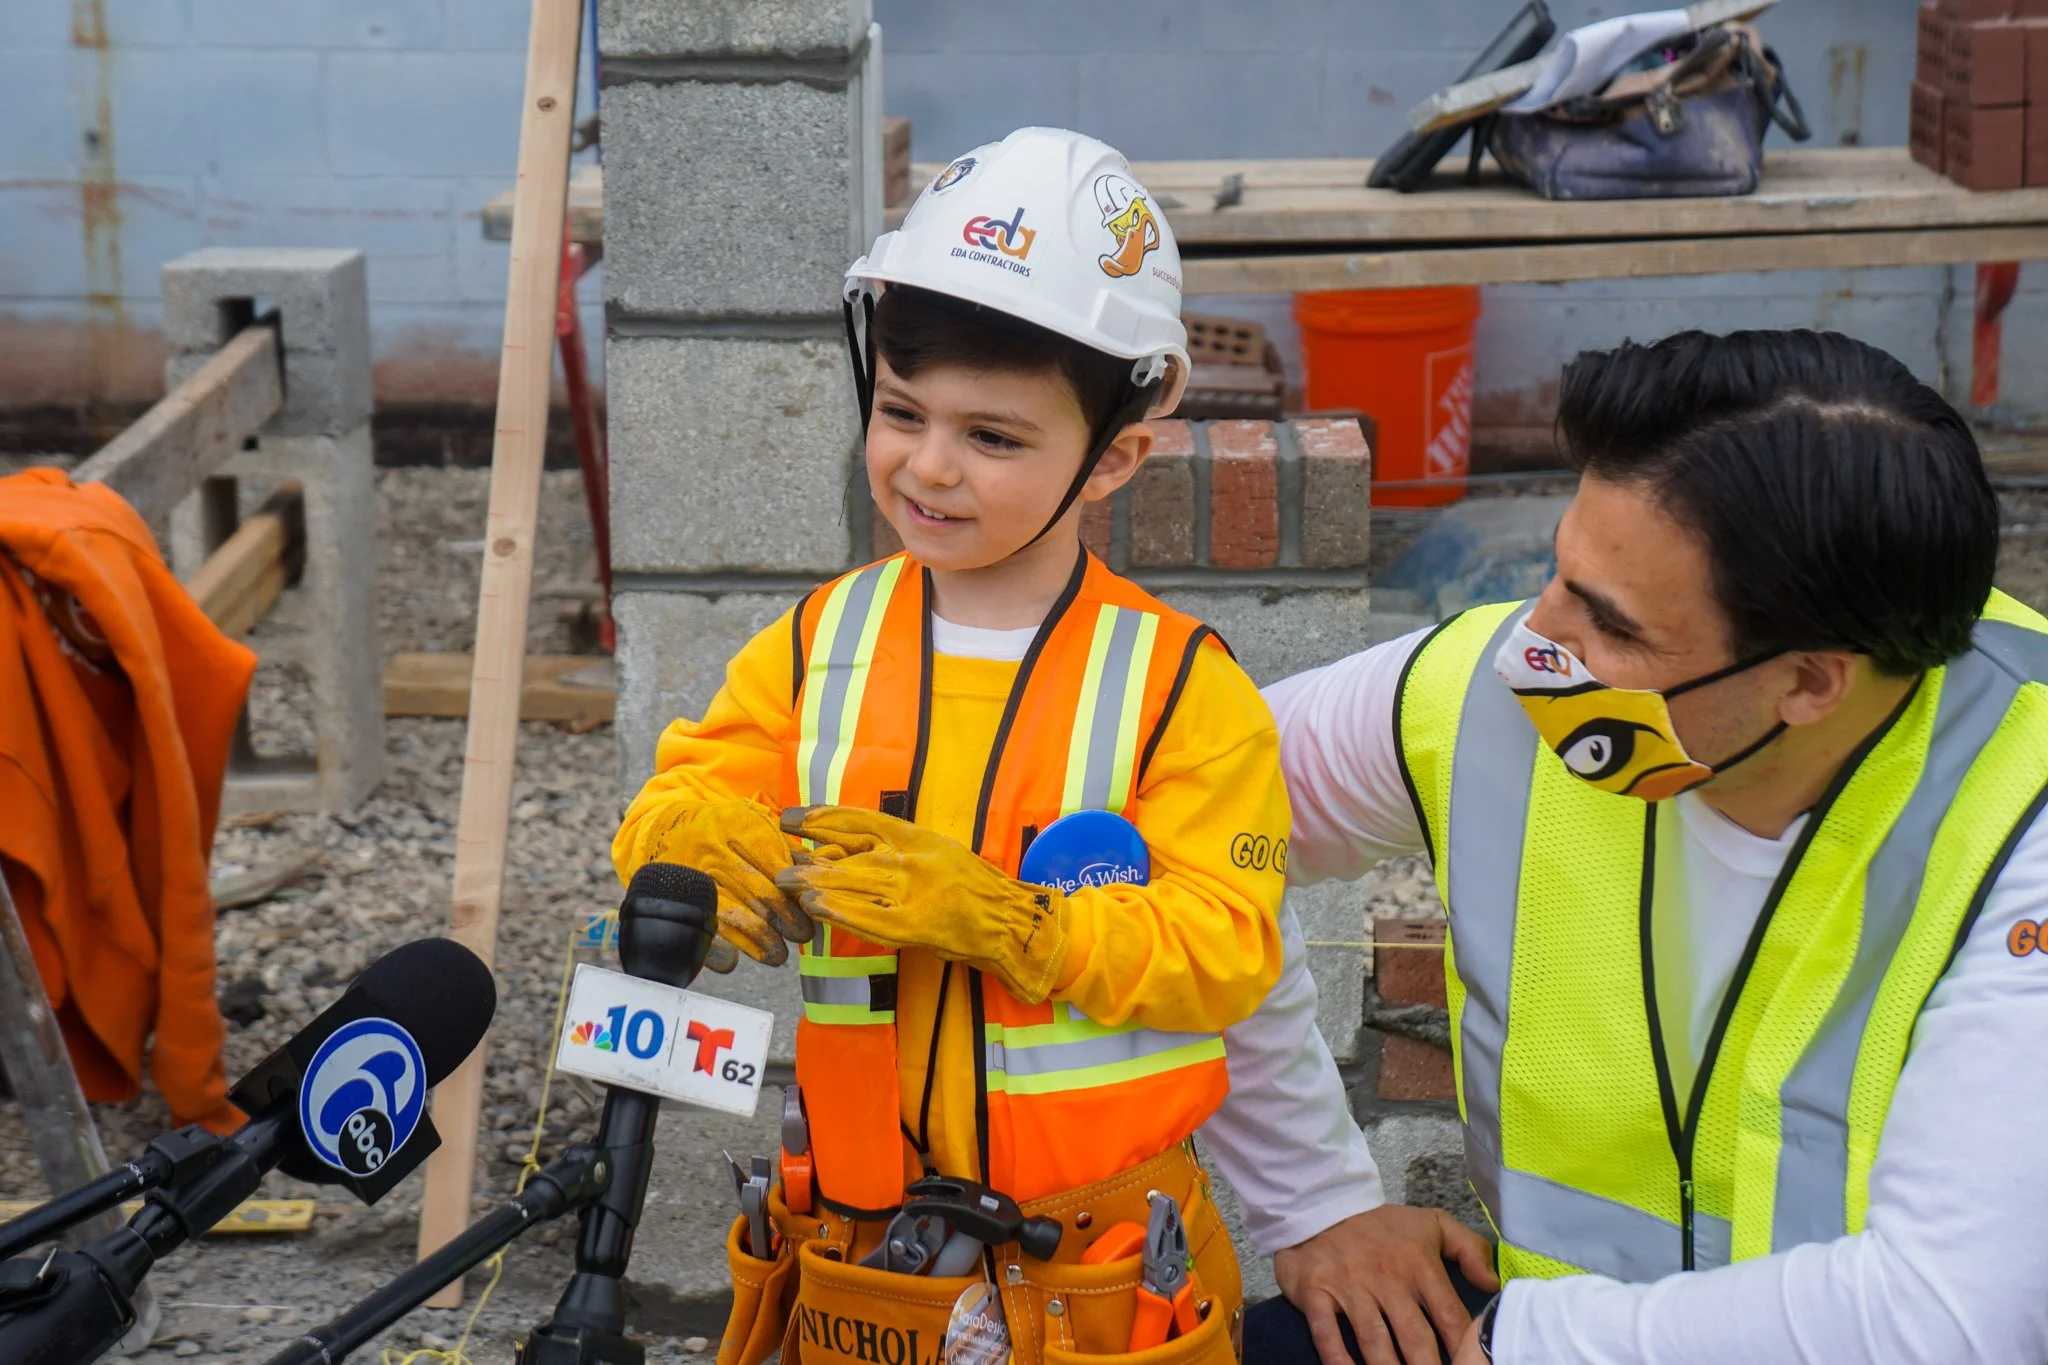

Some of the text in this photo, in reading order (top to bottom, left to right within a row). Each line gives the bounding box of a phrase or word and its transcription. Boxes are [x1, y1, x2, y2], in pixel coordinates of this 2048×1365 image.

[963, 207, 1036, 261] eda
[951, 247, 1031, 277] EDA CONTRACTORS
[1231, 832, 1270, 870] GO
[607, 1004, 665, 1060] 10
[721, 1059, 756, 1087] 62
[348, 1112, 385, 1170] abc
